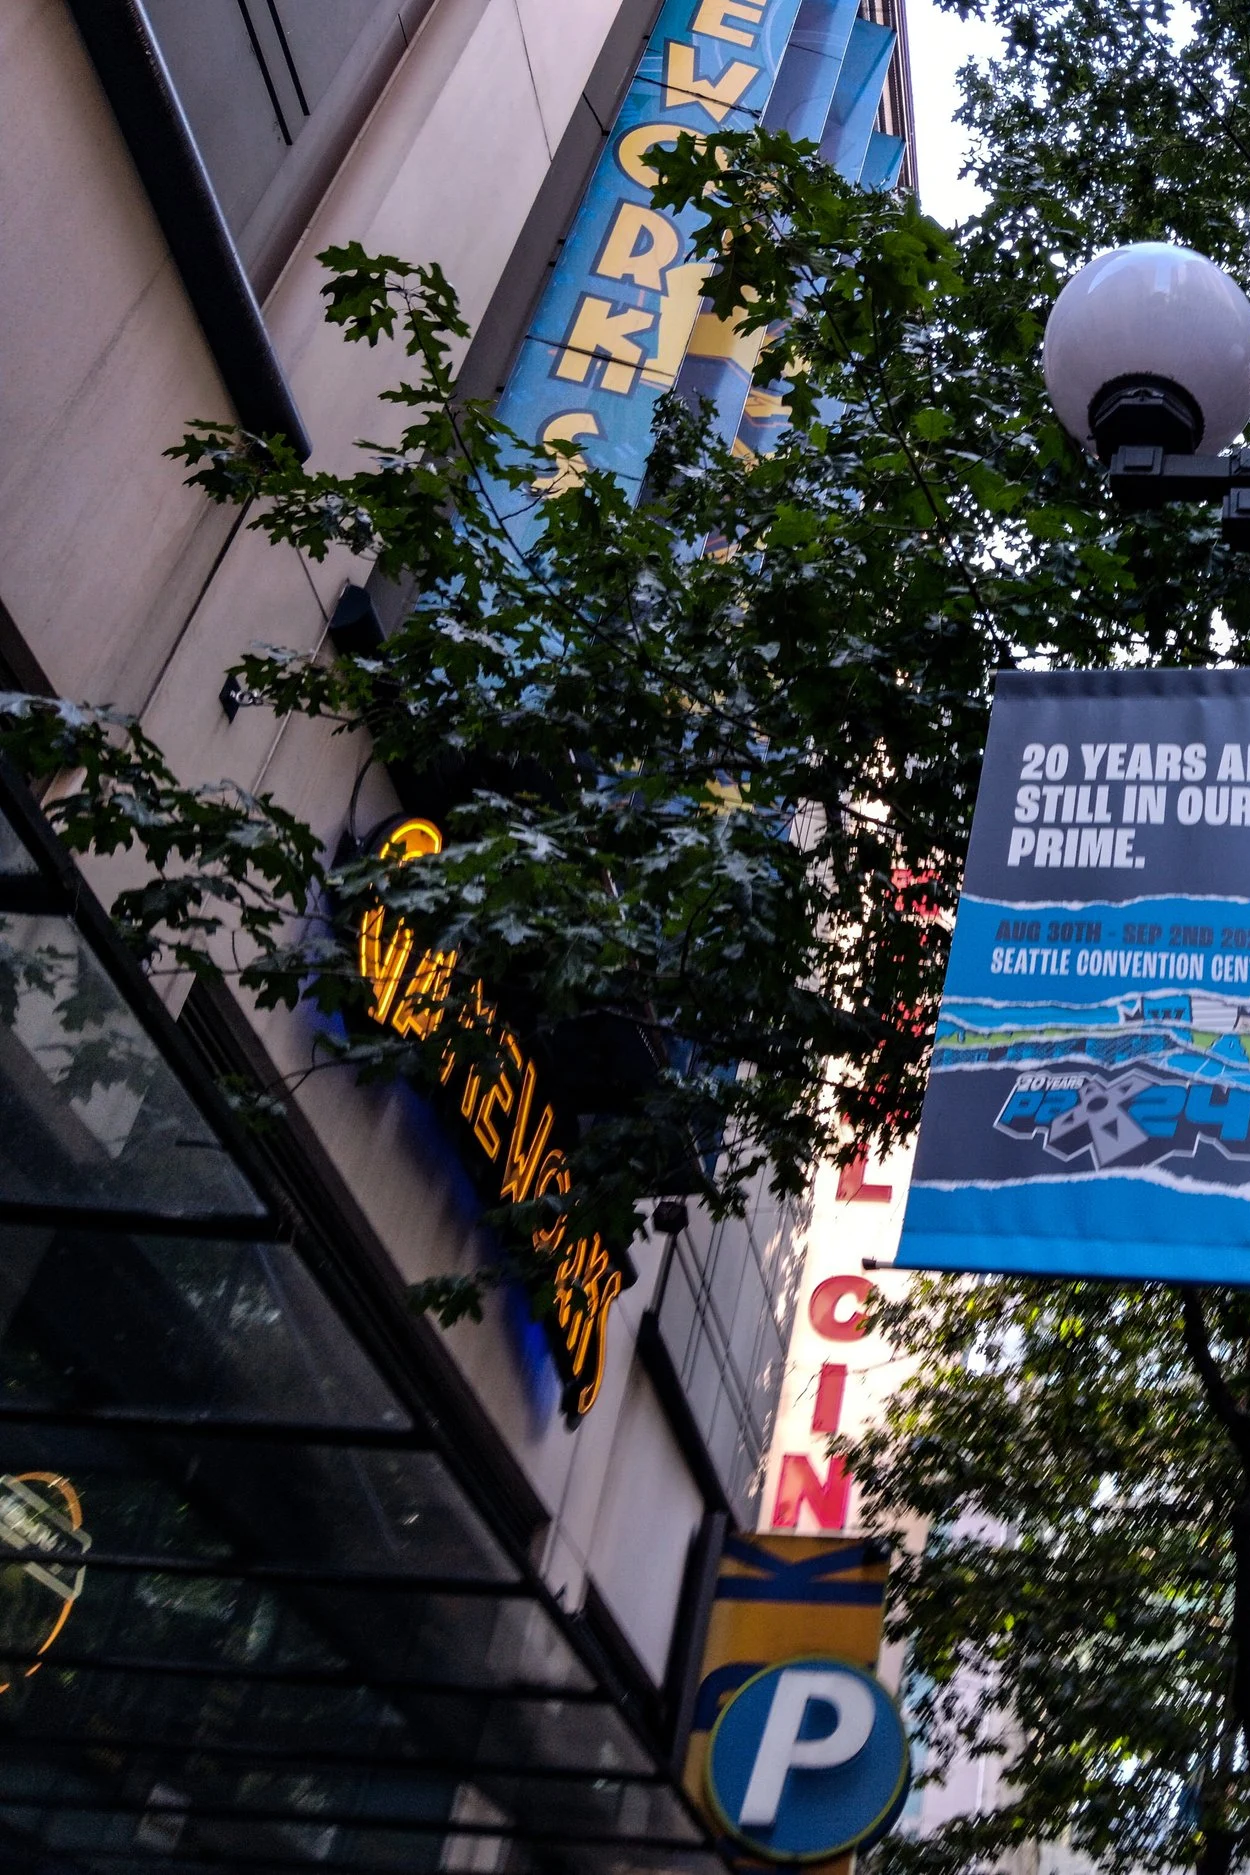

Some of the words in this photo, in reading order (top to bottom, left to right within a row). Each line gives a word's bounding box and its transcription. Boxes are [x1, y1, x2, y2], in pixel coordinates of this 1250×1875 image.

[1020, 743, 1069, 781] 20
[1080, 743, 1207, 782] YEARS
[1014, 784, 1111, 823] STILL
[1122, 785, 1167, 825] IN
[1007, 827, 1145, 869] PRIME.
[995, 919, 1041, 942] AUG
[1046, 920, 1102, 944] 30TH
[1122, 922, 1162, 946] SEP
[1168, 925, 1213, 948] 2ND
[990, 946, 1071, 976] SEATTLE
[1075, 948, 1204, 981] CONVENTION
[738, 1668, 876, 1826] P
